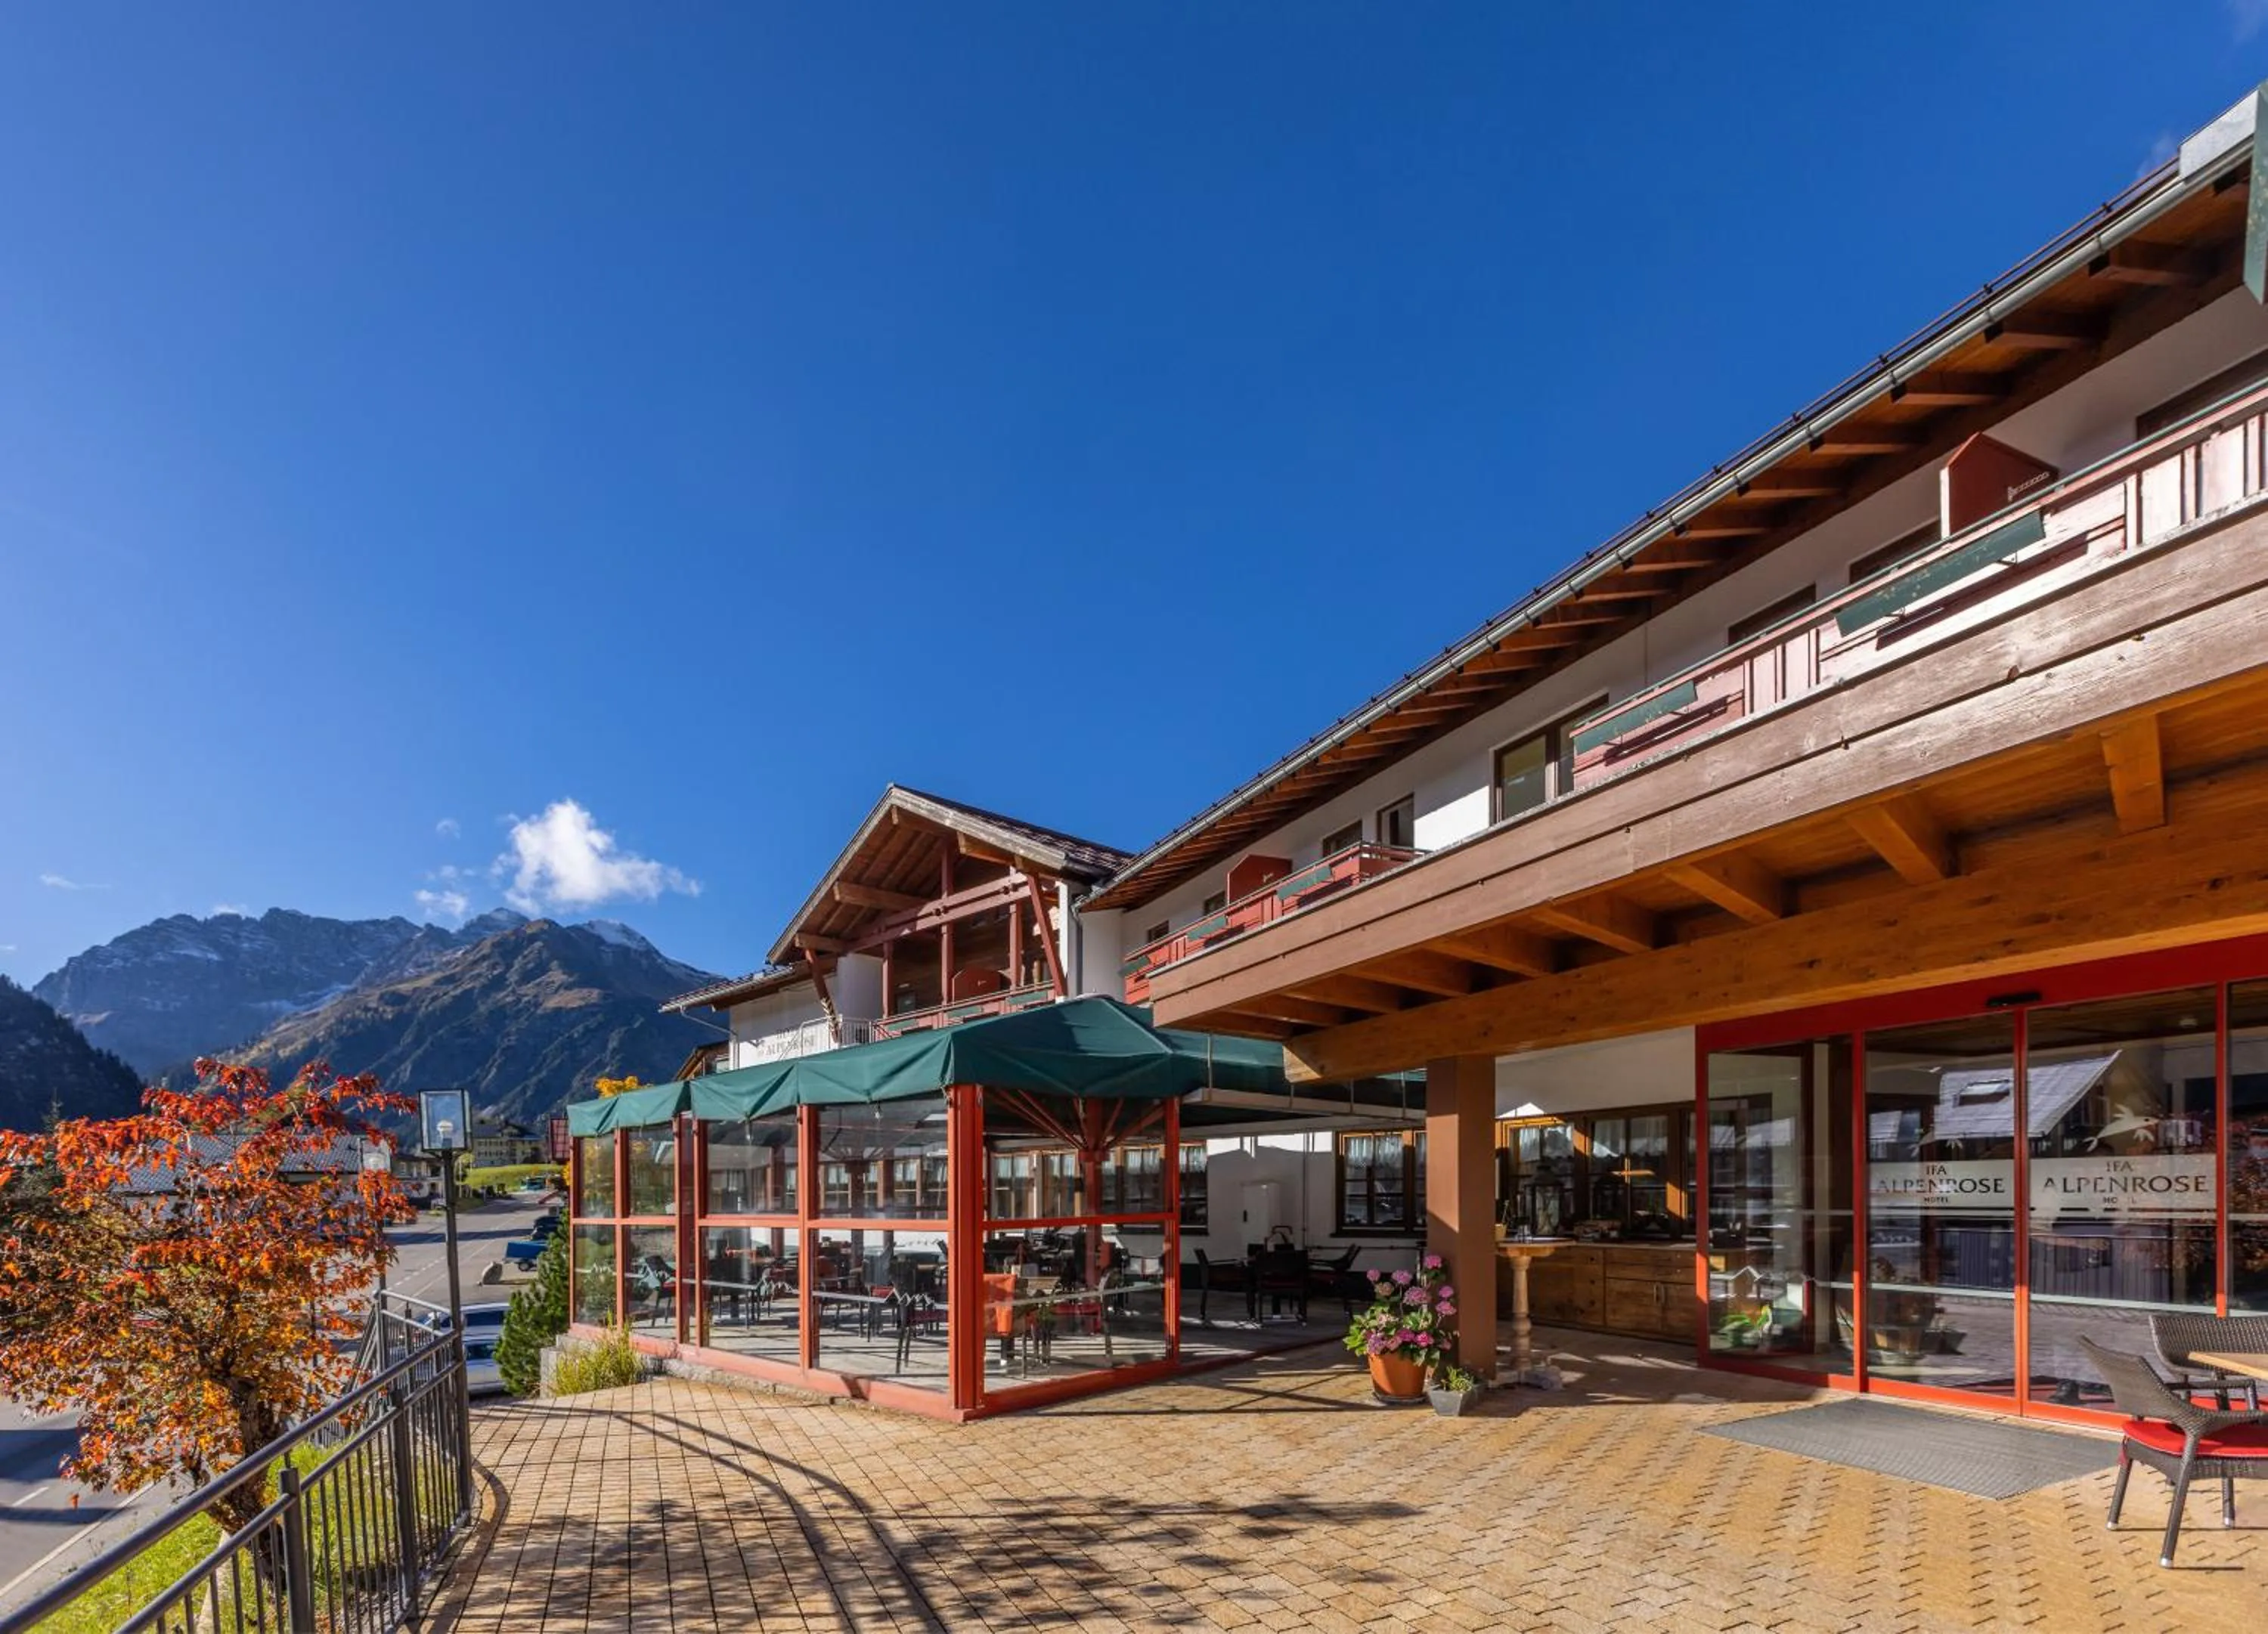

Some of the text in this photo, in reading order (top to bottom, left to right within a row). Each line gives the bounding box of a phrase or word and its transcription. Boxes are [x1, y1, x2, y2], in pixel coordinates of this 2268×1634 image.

[1926, 1165, 1947, 1175] IFA
[2105, 1160, 2133, 1172] IFA
[1875, 1178, 2006, 1194] ALPENROSE
[2043, 1174, 2209, 1193] ALPENROSE
